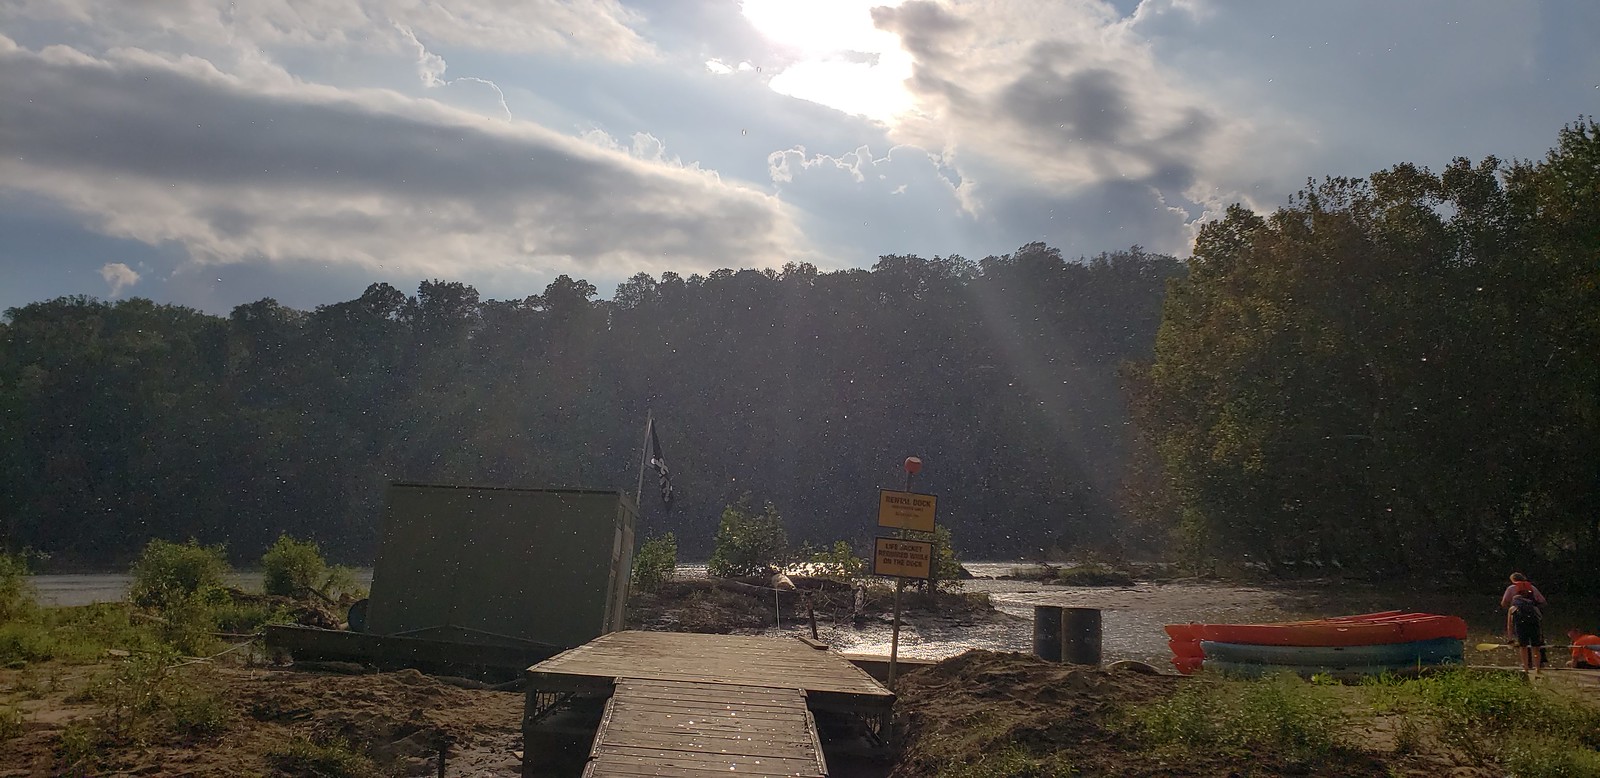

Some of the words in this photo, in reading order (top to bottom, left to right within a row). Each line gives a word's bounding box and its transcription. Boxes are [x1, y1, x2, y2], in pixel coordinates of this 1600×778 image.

[886, 496, 910, 506] RENTAL
[913, 498, 932, 508] DOCK
[878, 550, 908, 558] REQUIRED
[910, 552, 928, 560] WHILE
